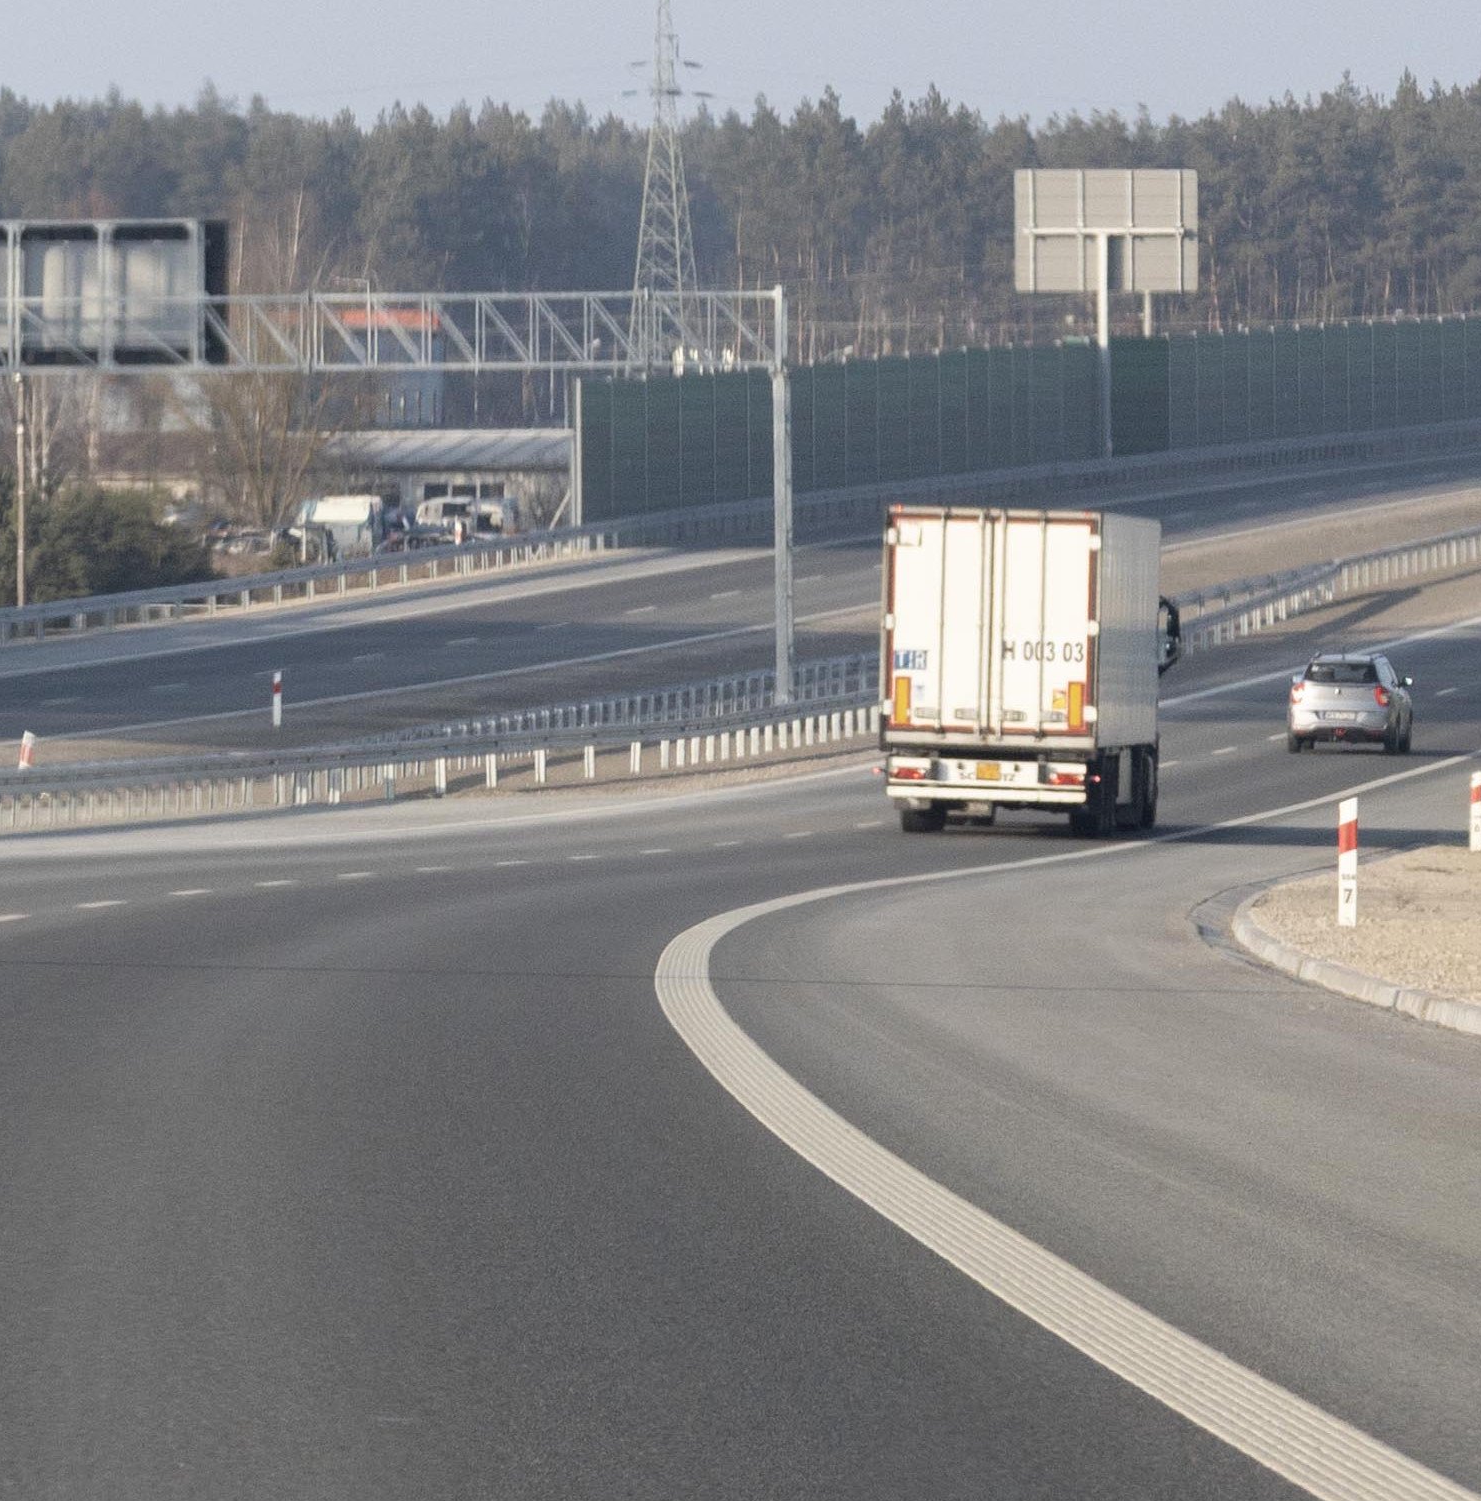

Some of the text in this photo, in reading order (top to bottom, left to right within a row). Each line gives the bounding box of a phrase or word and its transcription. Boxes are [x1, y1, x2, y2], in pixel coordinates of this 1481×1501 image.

[1023, 640, 1056, 663] 003
[1062, 642, 1084, 664] 03
[1343, 887, 1353, 904] 7
